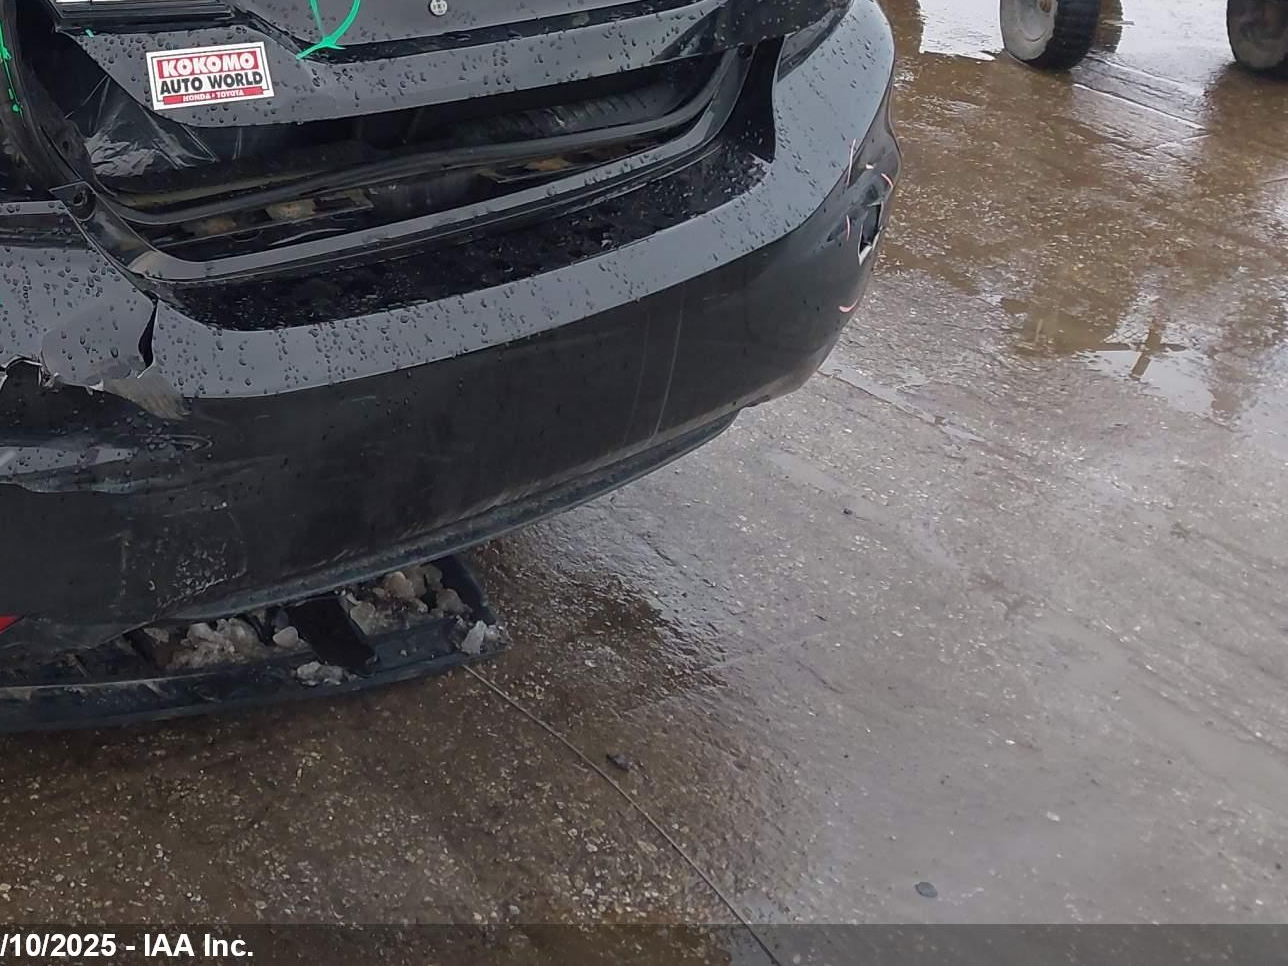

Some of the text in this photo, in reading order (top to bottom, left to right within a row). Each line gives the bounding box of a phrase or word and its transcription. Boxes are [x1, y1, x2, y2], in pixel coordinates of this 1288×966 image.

[162, 53, 255, 78] KOKOMO
[160, 71, 263, 95] AUTO WORLD
[216, 89, 244, 98] TOYOTA
